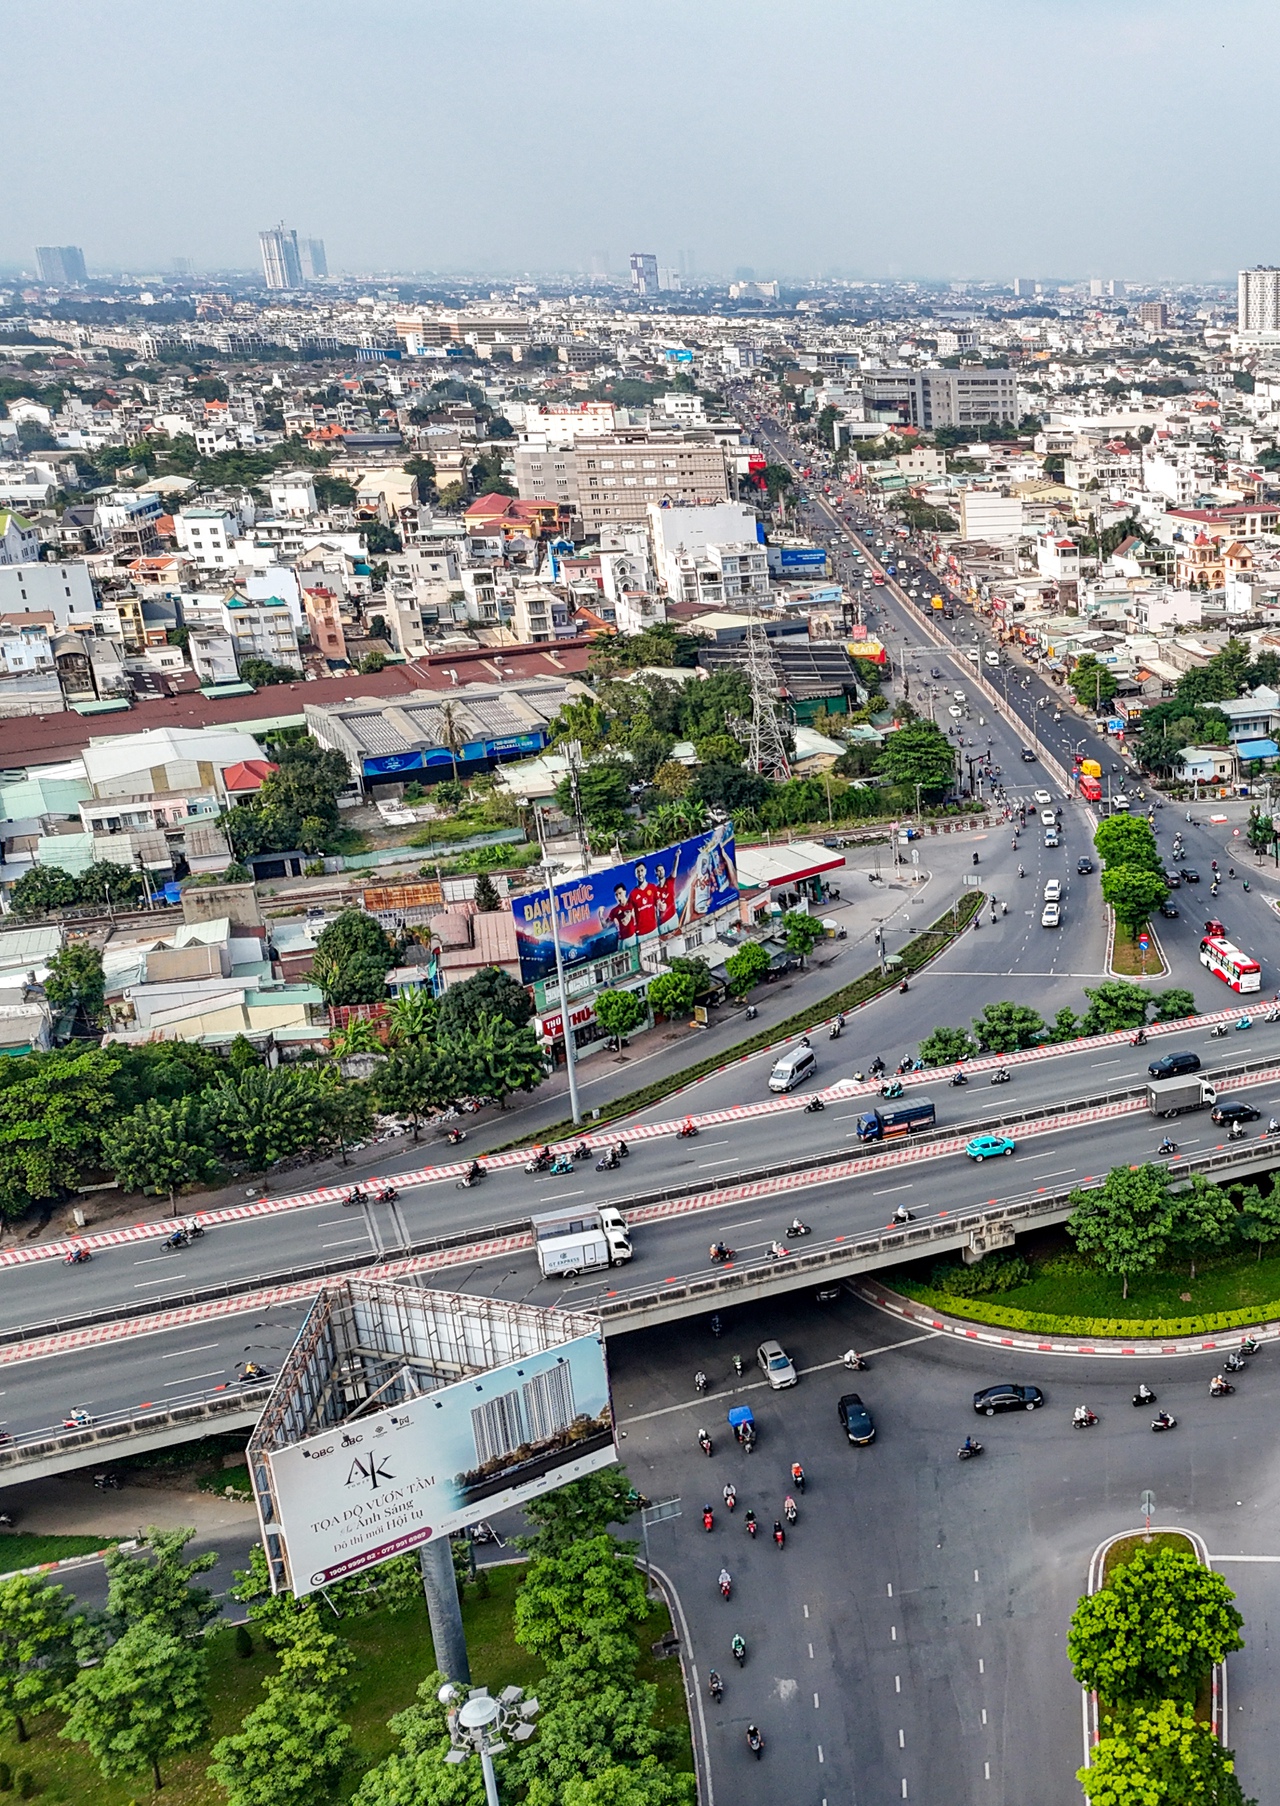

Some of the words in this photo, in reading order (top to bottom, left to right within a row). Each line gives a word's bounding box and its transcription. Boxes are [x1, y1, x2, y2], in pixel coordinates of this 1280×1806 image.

[560, 883, 594, 909] THỨC
[560, 903, 591, 927] LĨNH
[557, 1257, 580, 1266] EXPRESS
[310, 1516, 340, 1533] TỌA
[343, 1504, 363, 1521] ĐỘ
[366, 1488, 404, 1511] VƯƠN
[406, 1476, 436, 1494] TẦM
[384, 1499, 414, 1518] Sáng
[333, 1542, 348, 1553] Đô
[349, 1533, 364, 1546] thị
[365, 1525, 384, 1540] mới
[386, 1514, 408, 1530] Hội
[411, 1509, 424, 1520] tụ
[329, 1565, 347, 1576] 1900
